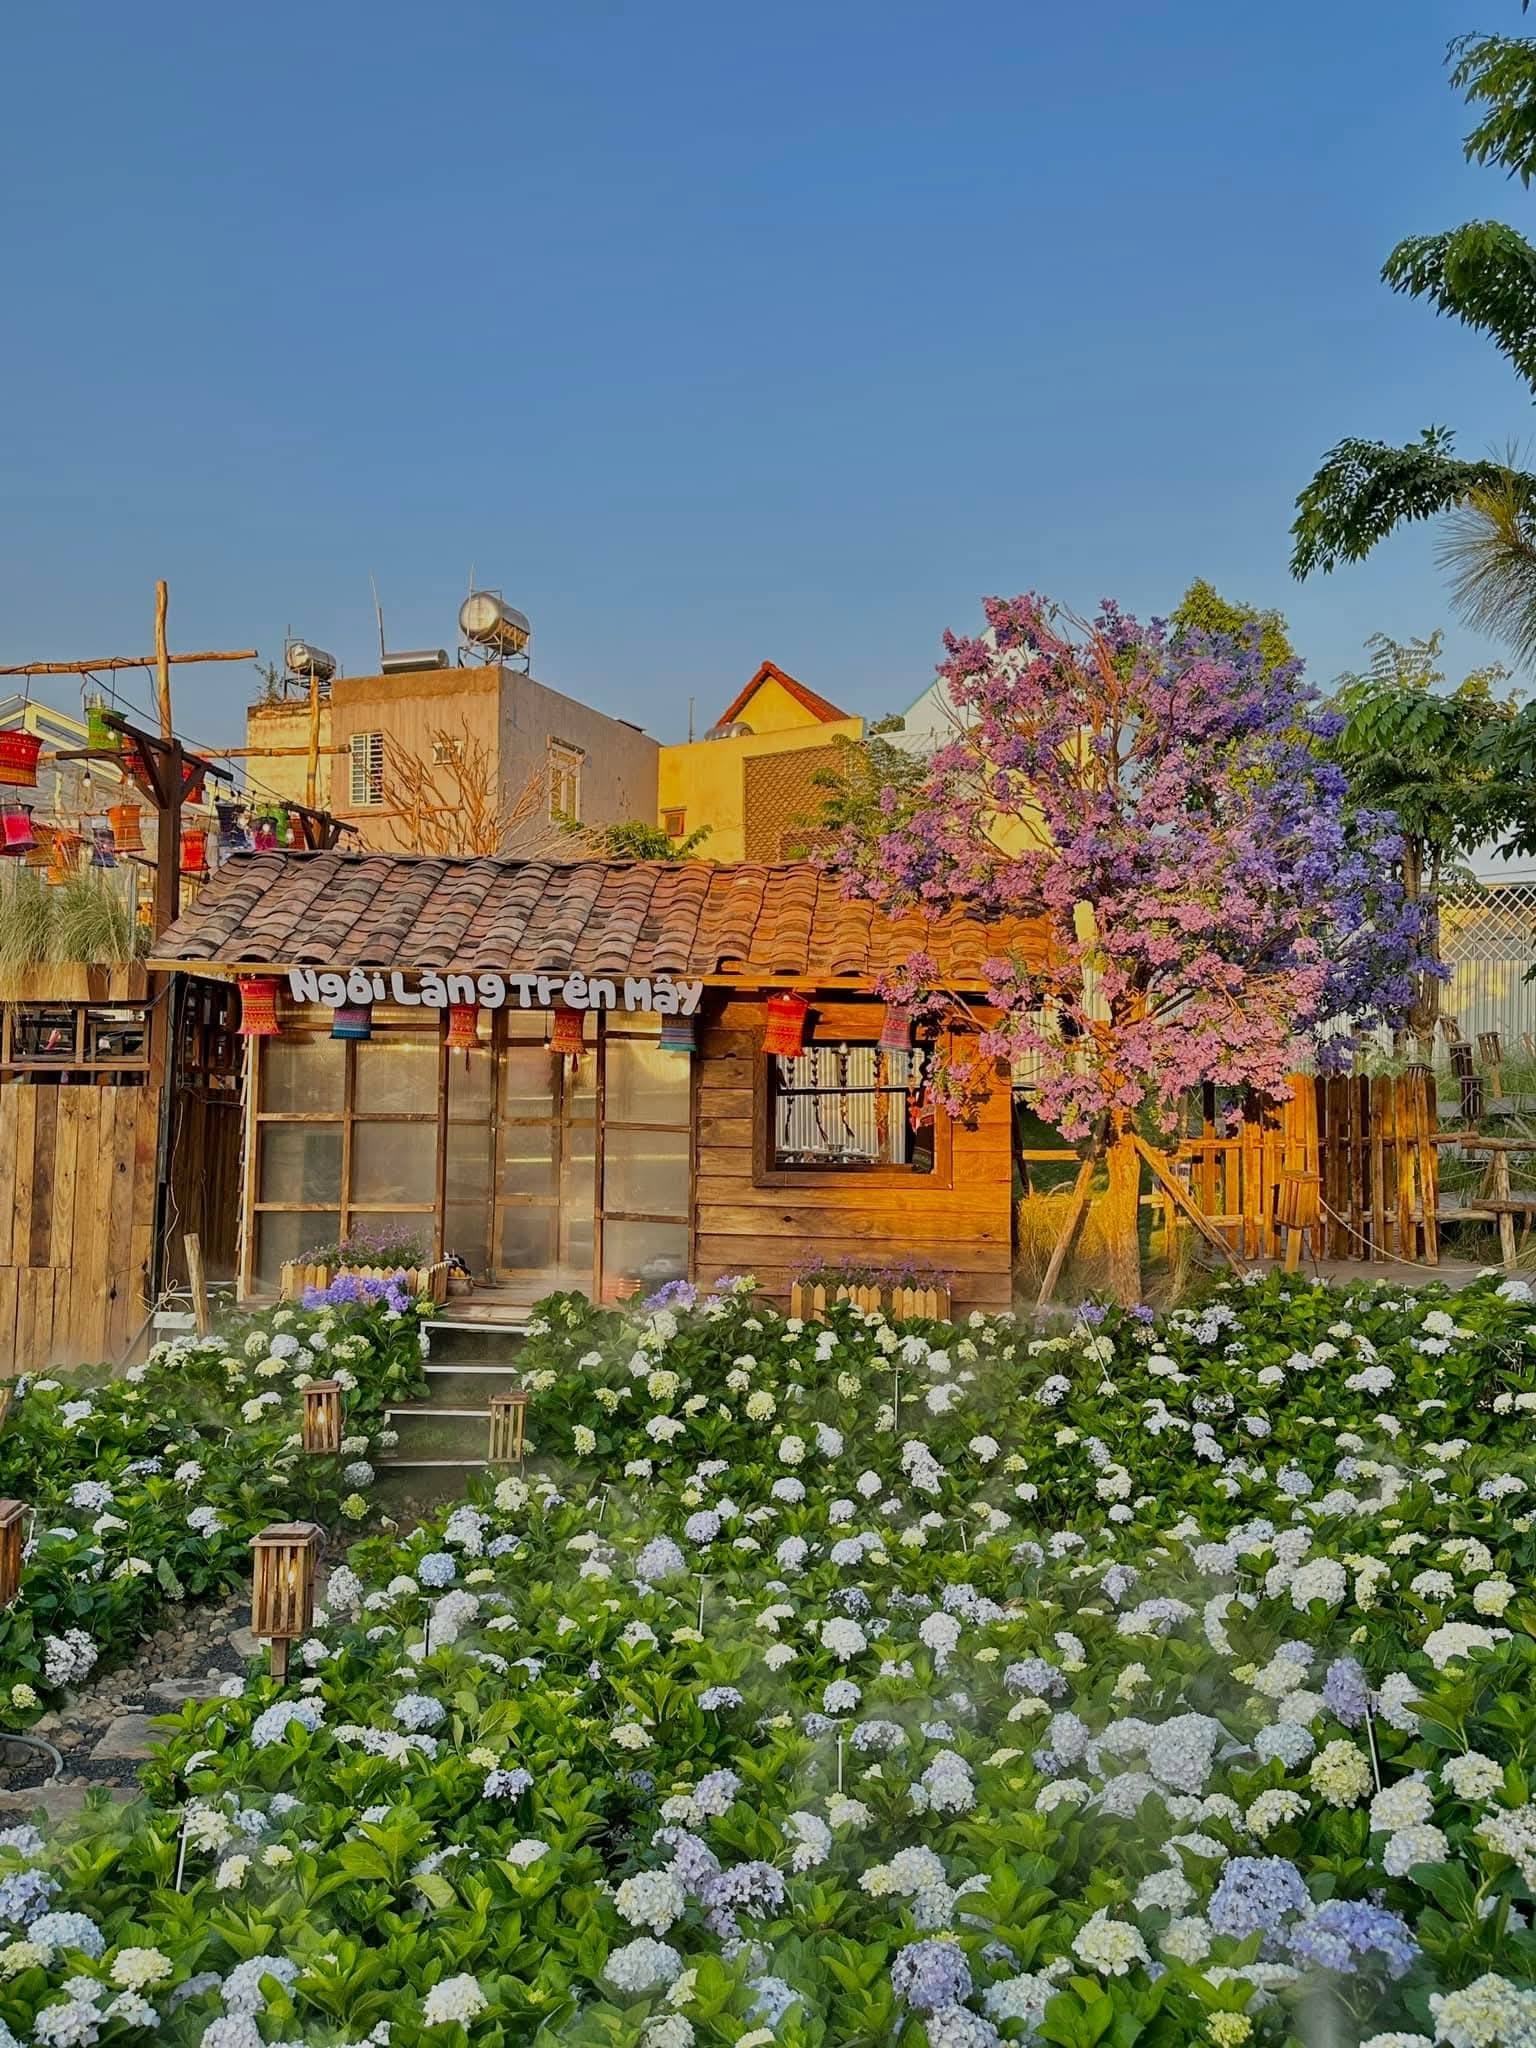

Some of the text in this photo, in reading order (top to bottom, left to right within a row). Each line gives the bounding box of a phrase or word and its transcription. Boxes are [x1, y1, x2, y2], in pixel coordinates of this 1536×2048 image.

[289, 968, 703, 1015] Ngôi Làng Trên Mây
